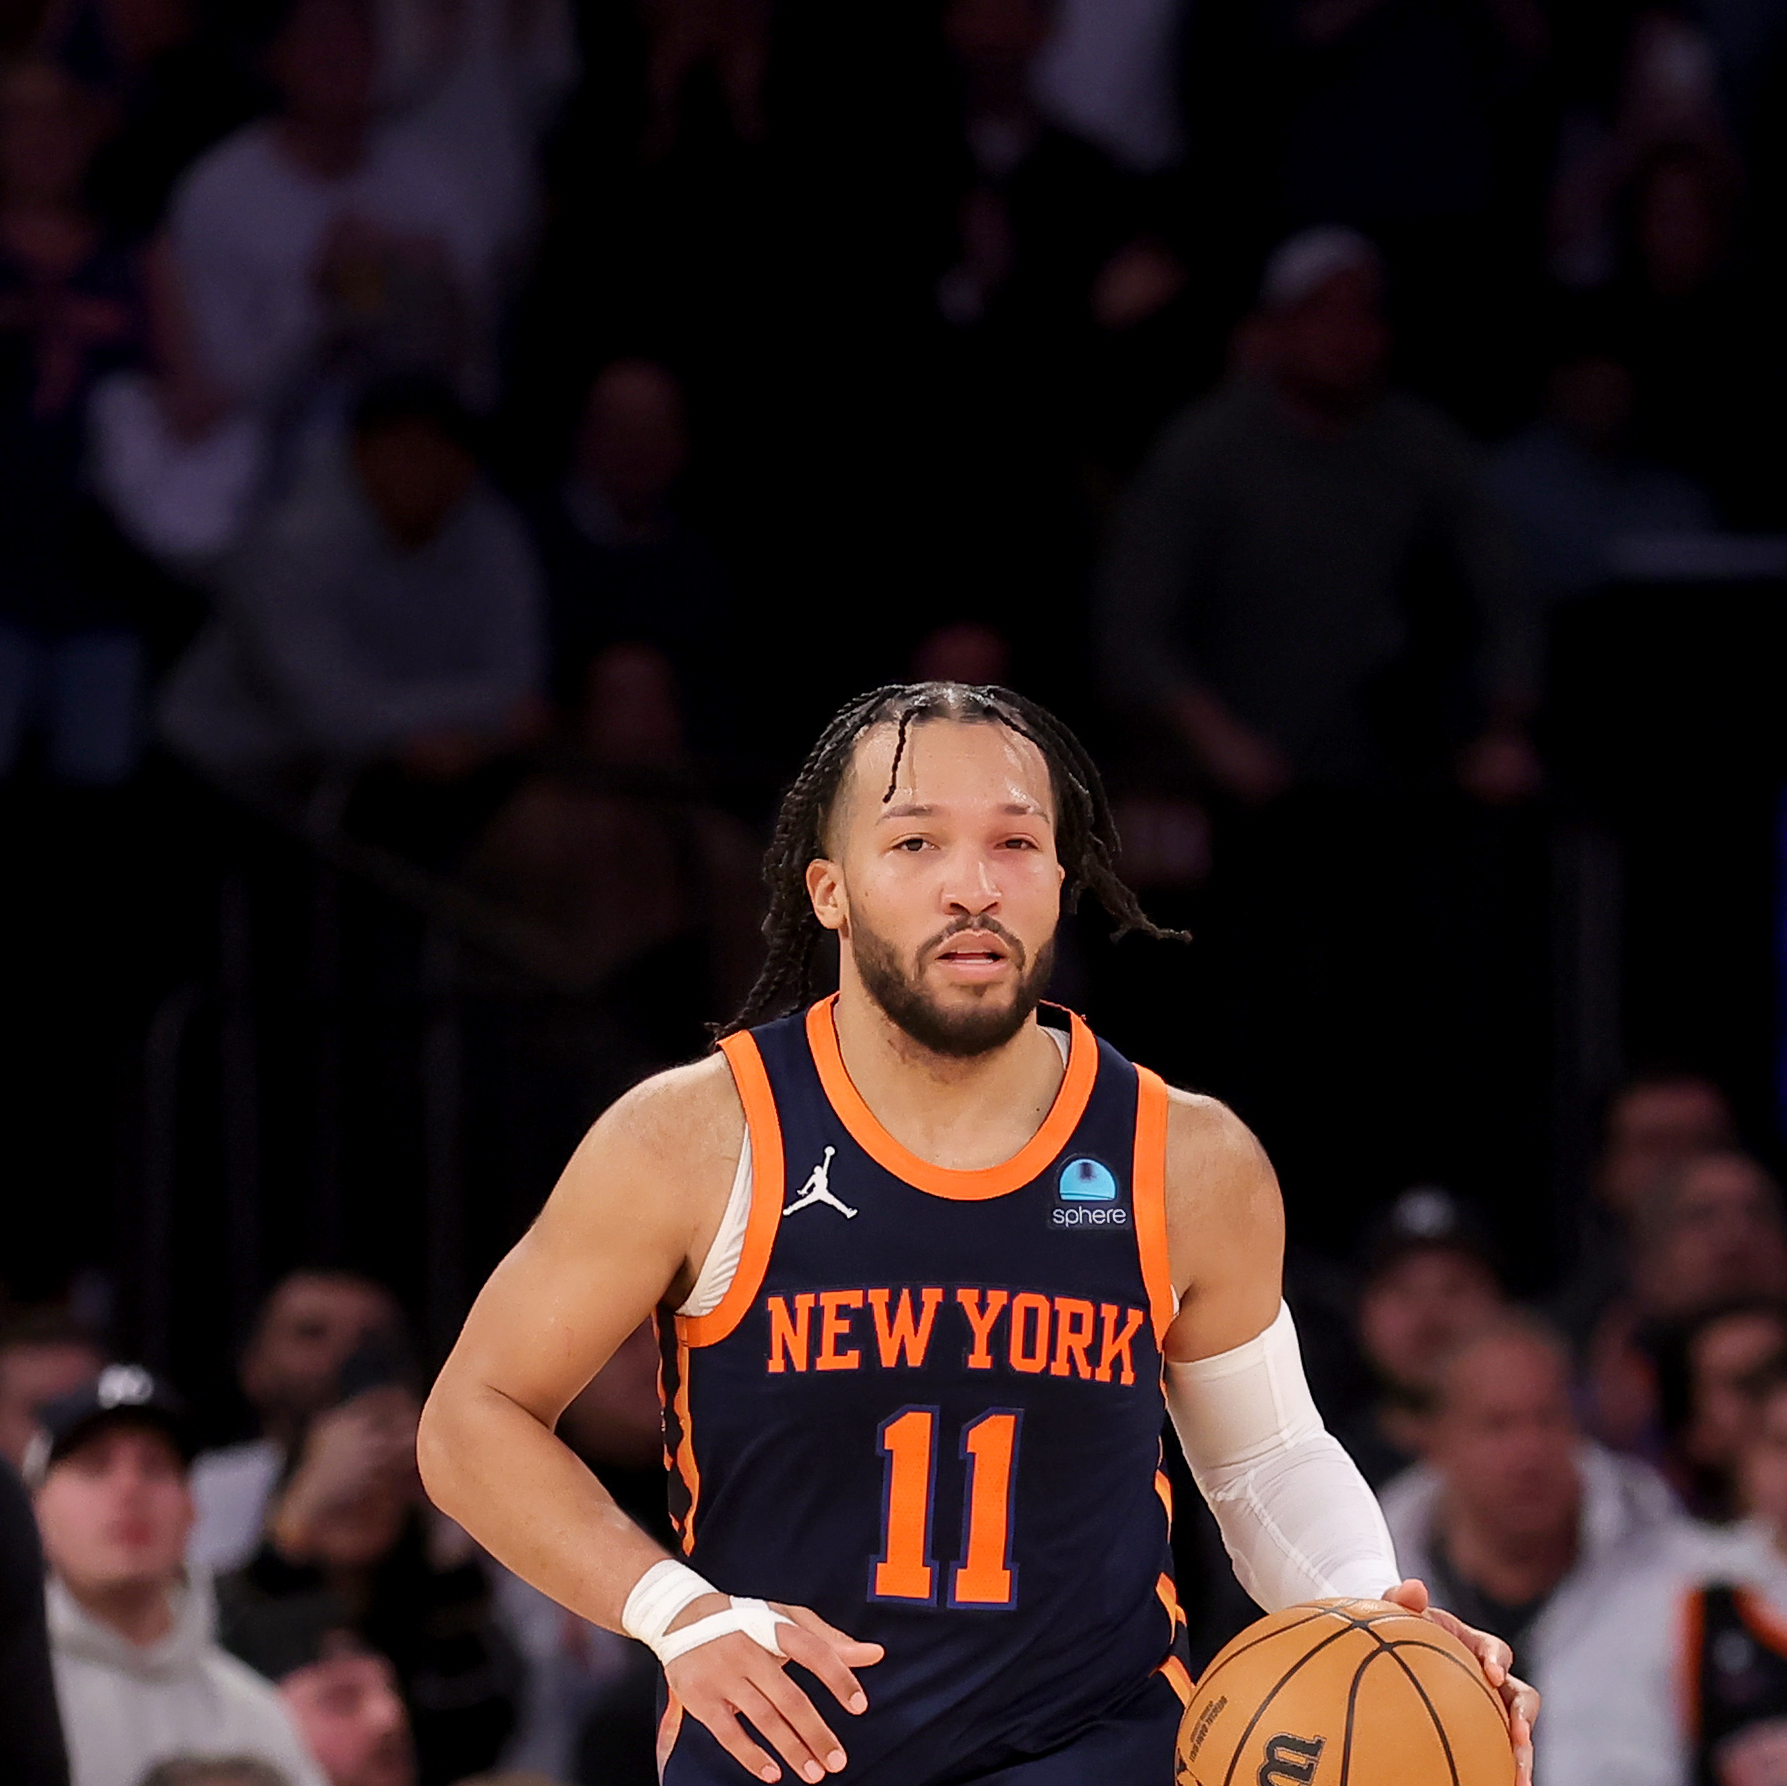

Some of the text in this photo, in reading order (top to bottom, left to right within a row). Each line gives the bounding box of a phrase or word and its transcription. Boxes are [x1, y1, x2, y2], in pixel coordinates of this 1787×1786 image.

[1052, 1205, 1127, 1228] sphere
[766, 1286, 1145, 1386] NEW YORK
[866, 1403, 1025, 1611] 11
